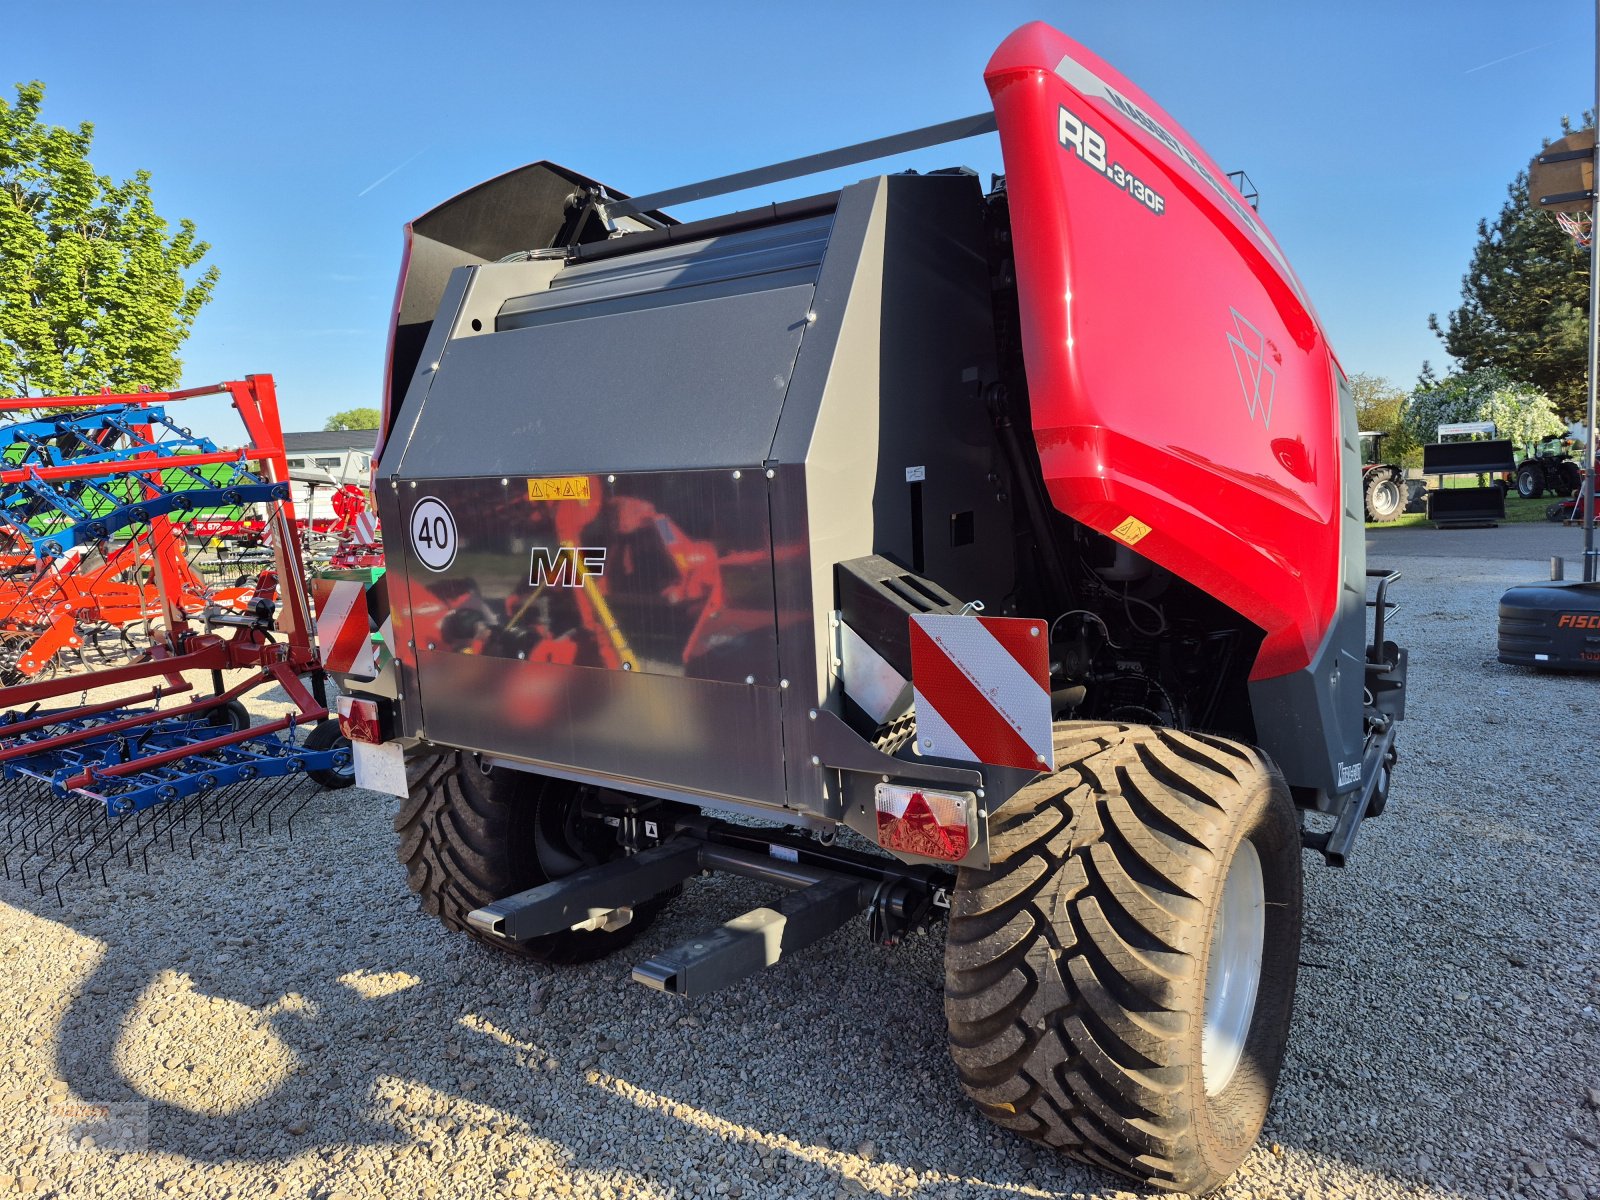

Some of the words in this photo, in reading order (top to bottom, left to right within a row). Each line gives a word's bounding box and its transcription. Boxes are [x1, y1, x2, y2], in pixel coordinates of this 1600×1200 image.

[418, 516, 449, 549] 40
[529, 546, 607, 588] MF
[1558, 615, 1600, 629] FISC
